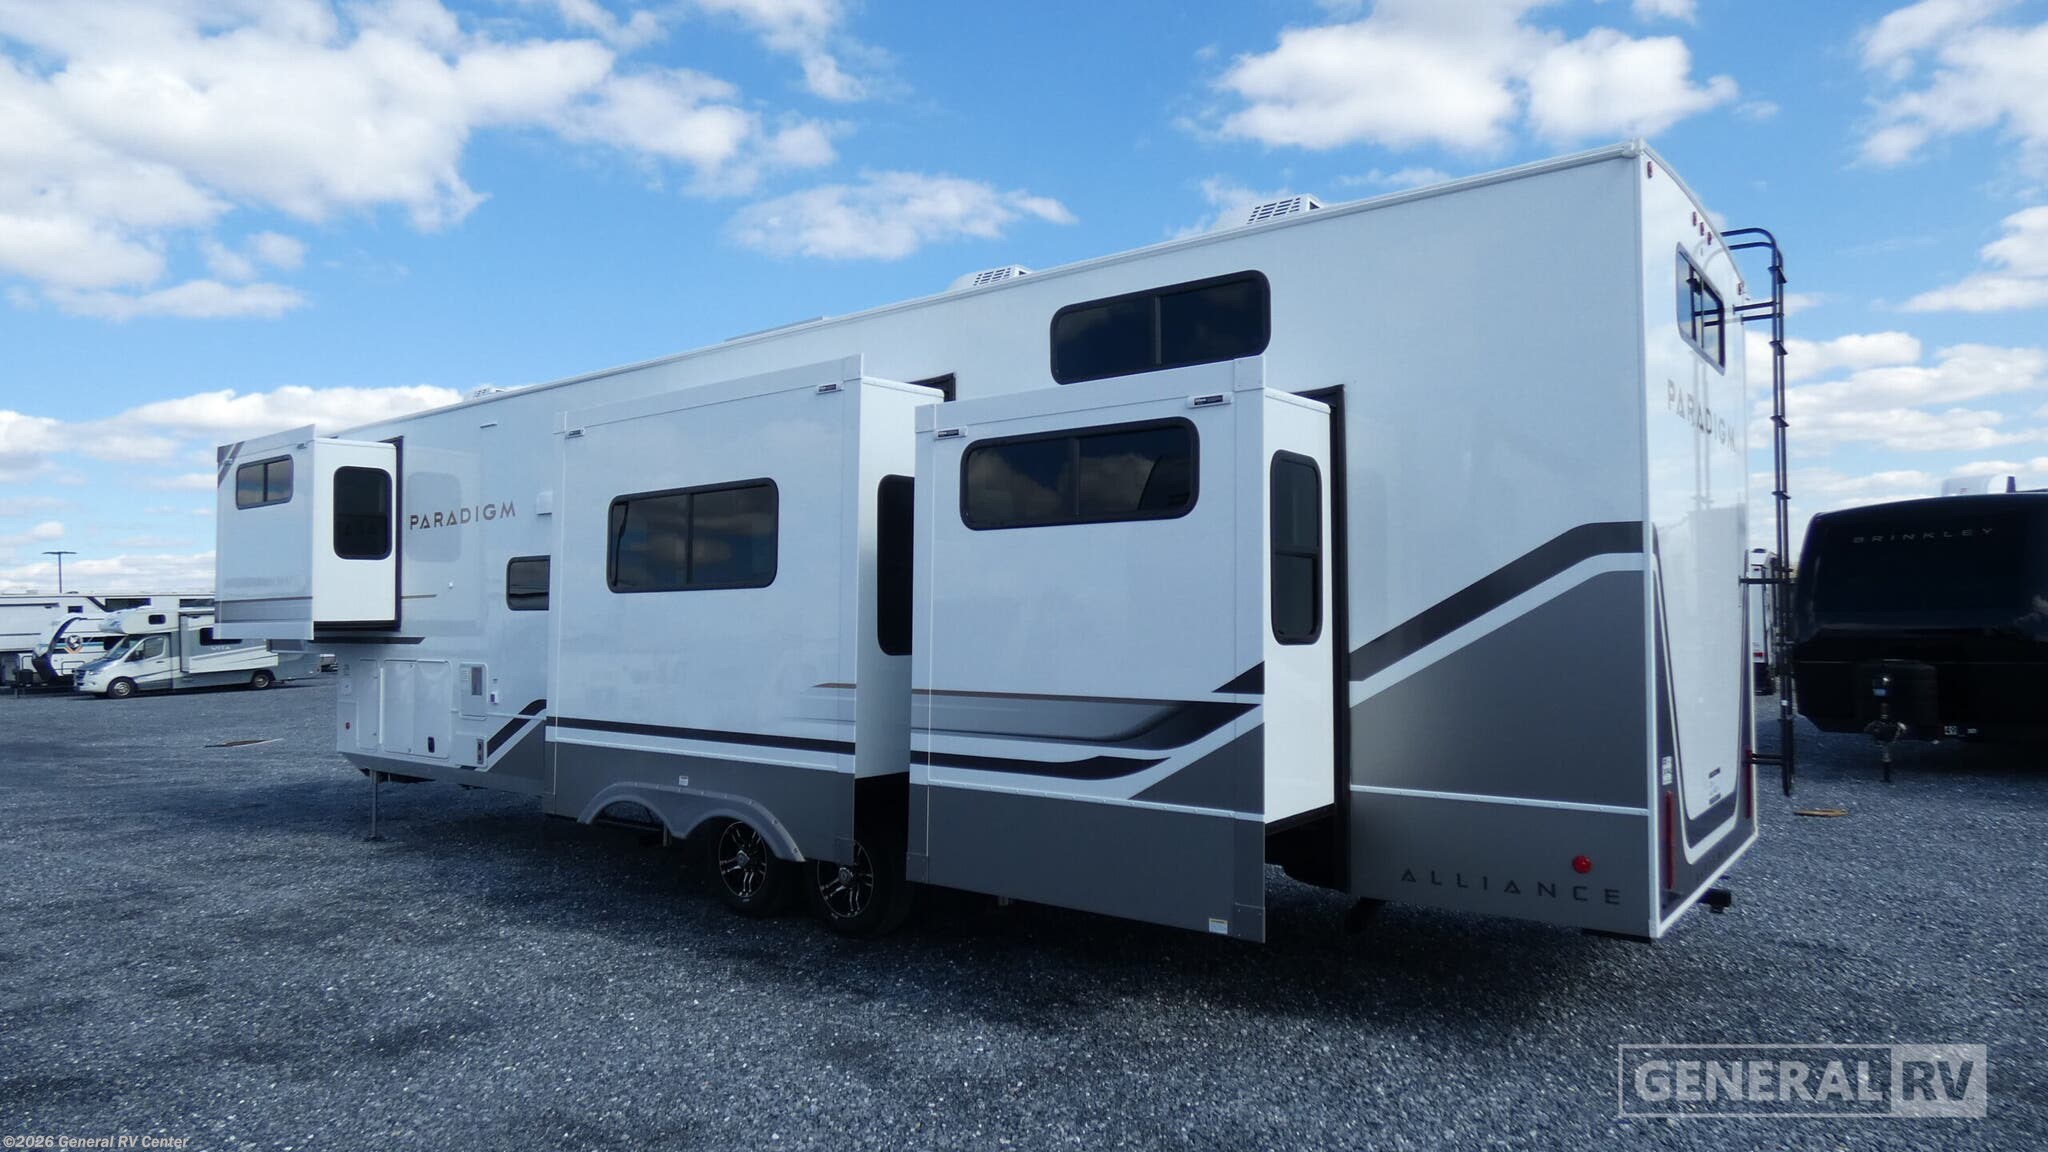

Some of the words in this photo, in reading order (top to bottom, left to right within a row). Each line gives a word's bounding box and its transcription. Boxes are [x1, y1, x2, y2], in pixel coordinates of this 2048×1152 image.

[1667, 379, 1736, 452] PARADIGM
[409, 501, 516, 530] PARADIGM
[1852, 527, 1993, 543] BRINKLEY
[1401, 868, 1621, 905] ALLIANCE
